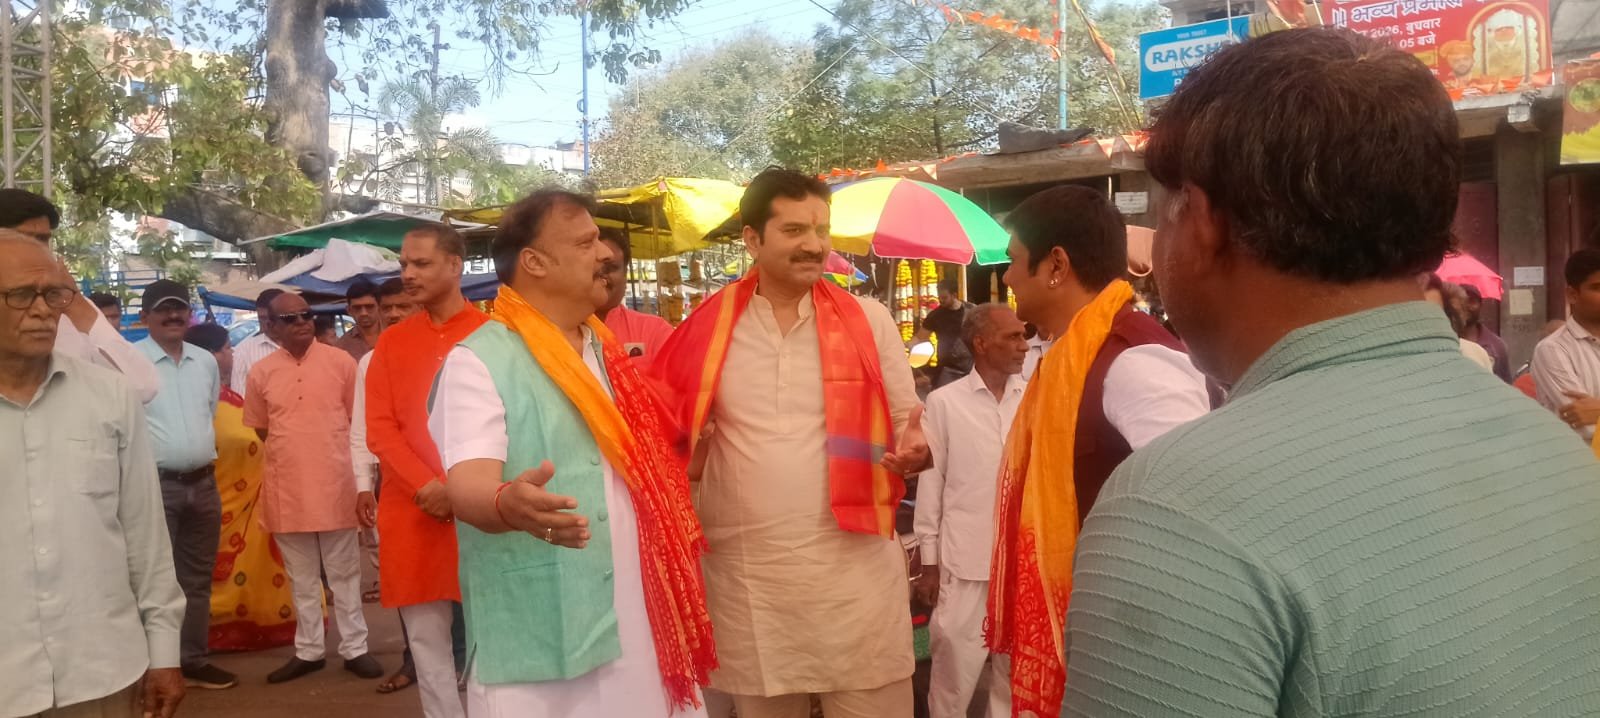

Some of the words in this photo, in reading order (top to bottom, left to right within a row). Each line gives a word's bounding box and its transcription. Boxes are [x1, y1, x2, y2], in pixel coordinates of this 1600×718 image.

[1352, 0, 1398, 22] भव्य
[1416, 31, 1435, 45] बजे
[1152, 43, 1222, 64] RAKSH
